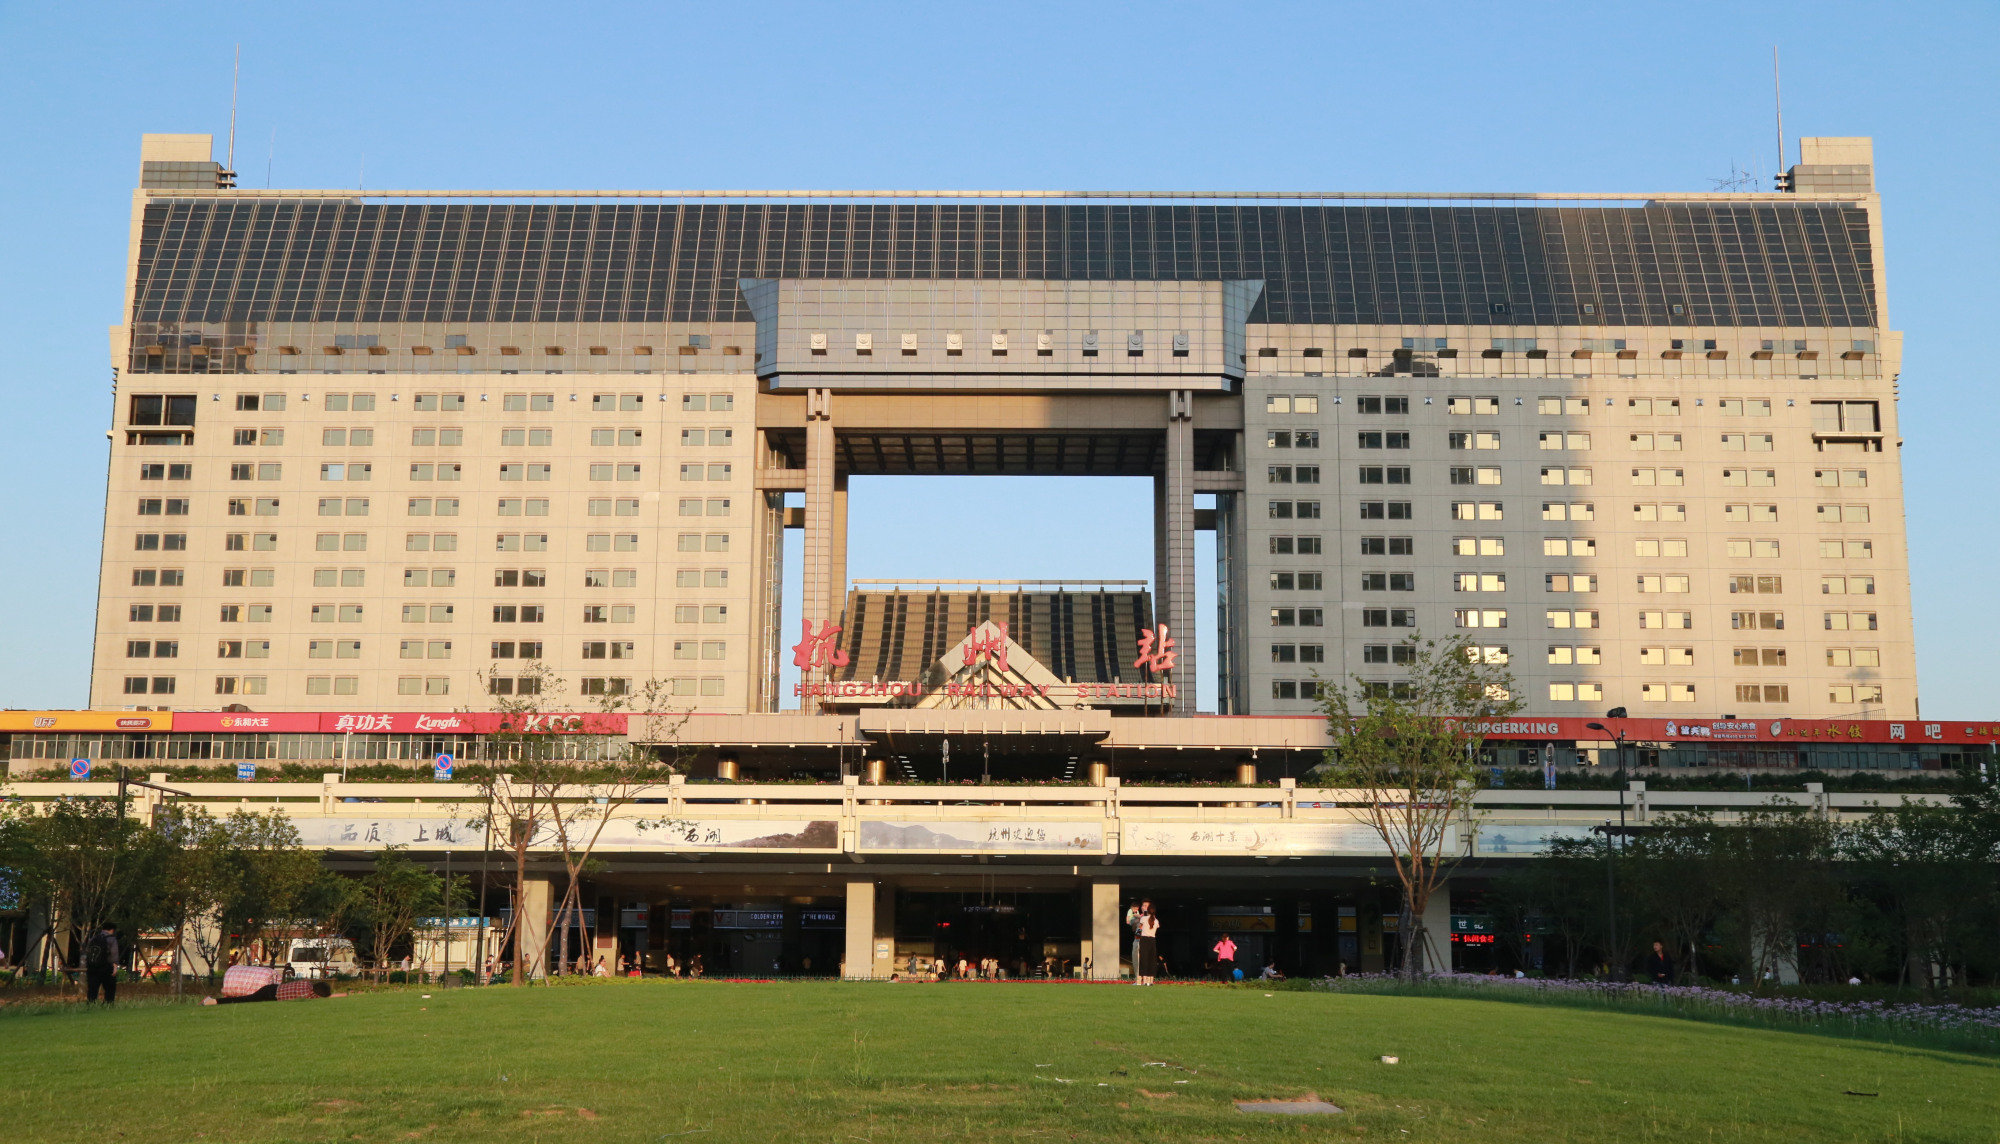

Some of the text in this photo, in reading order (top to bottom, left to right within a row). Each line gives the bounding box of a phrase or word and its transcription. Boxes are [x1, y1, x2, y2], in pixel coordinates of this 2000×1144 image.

[792, 618, 1179, 673] 杭州站
[794, 682, 1177, 699] HANGZHOU RAILWAY STATION
[33, 717, 56, 728] UFF
[233, 717, 269, 727] 永和大王
[335, 714, 394, 730] 真功夫
[415, 714, 461, 730] Kungfu
[523, 714, 581, 732] KFC
[1889, 723, 1943, 740] 网吧
